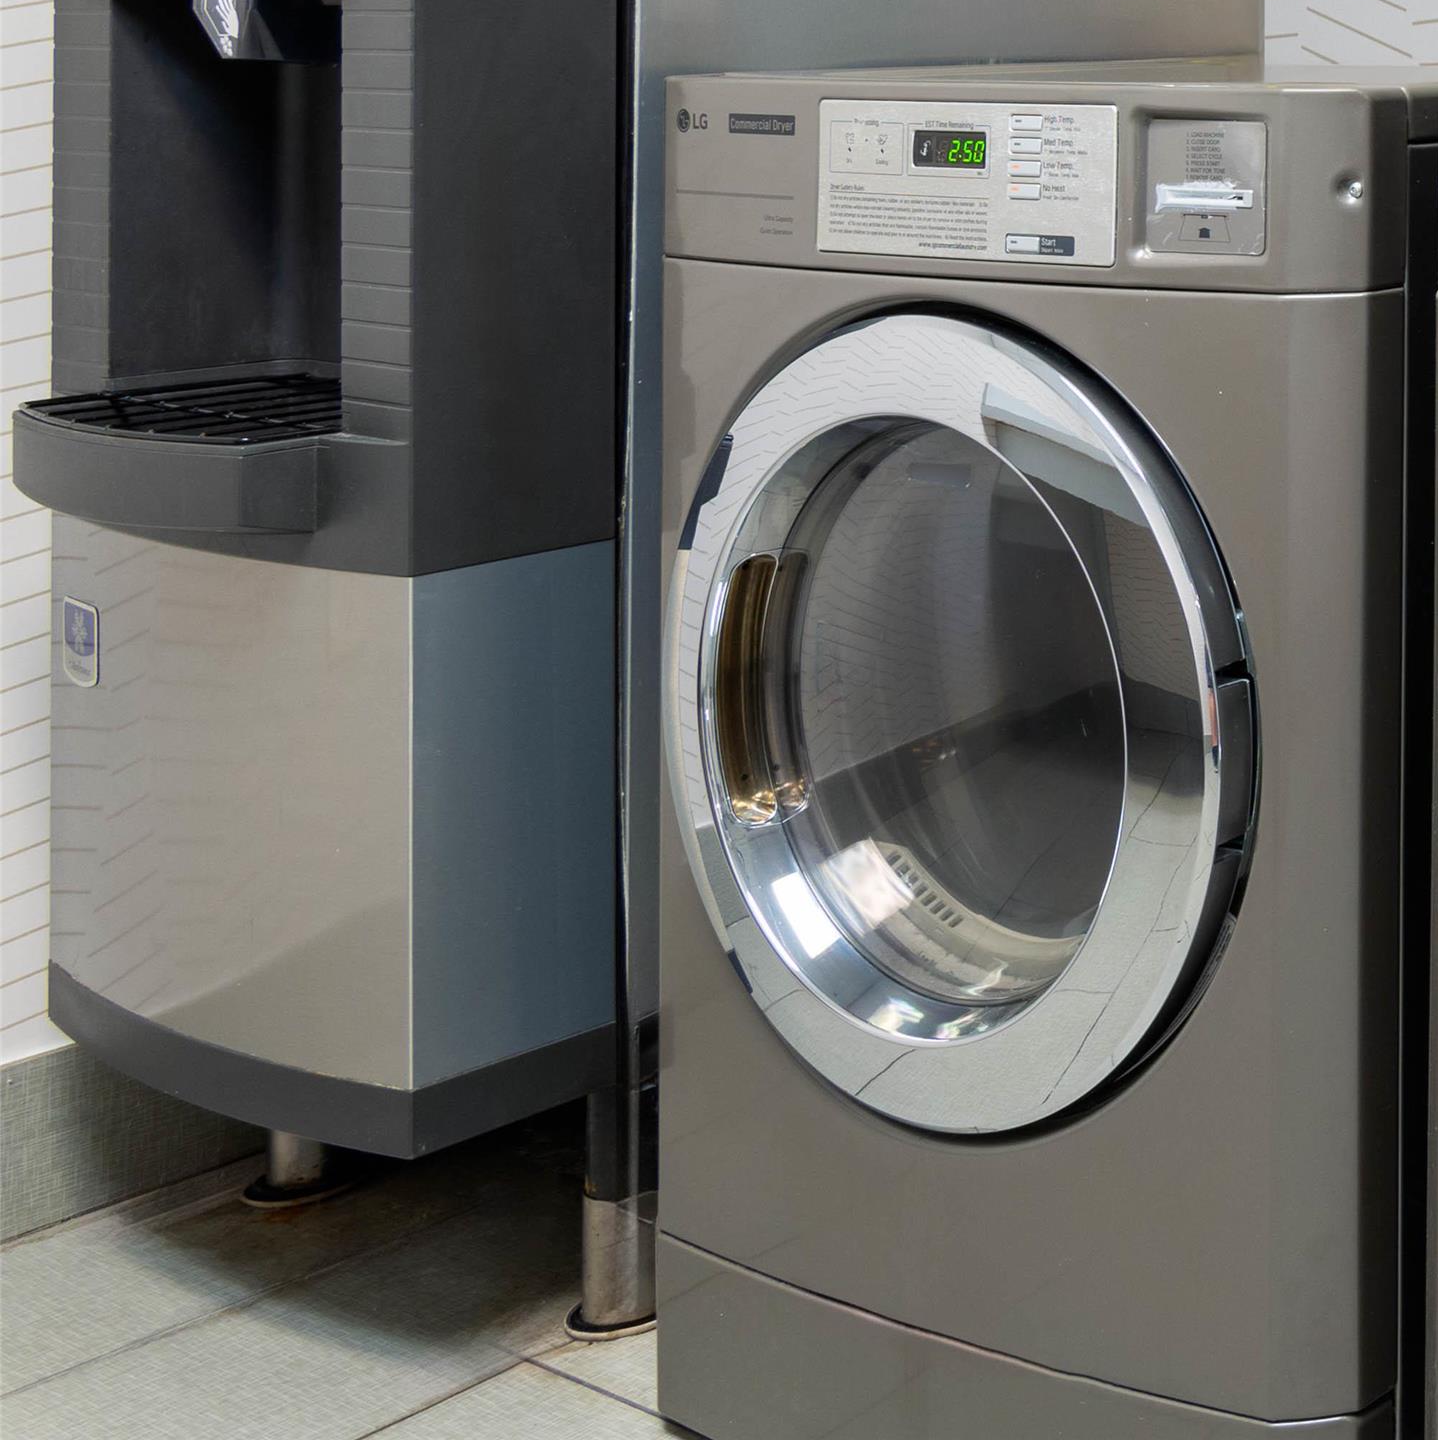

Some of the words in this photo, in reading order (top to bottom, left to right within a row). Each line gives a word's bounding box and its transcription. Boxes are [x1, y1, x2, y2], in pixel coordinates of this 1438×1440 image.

[693, 113, 708, 130] LG
[730, 117, 772, 130] Commercial
[773, 120, 795, 133] Dryer
[948, 140, 985, 163] 2.50
[1042, 161, 1055, 169] Low
[1051, 184, 1065, 192] Heat
[1041, 238, 1056, 247] Start
